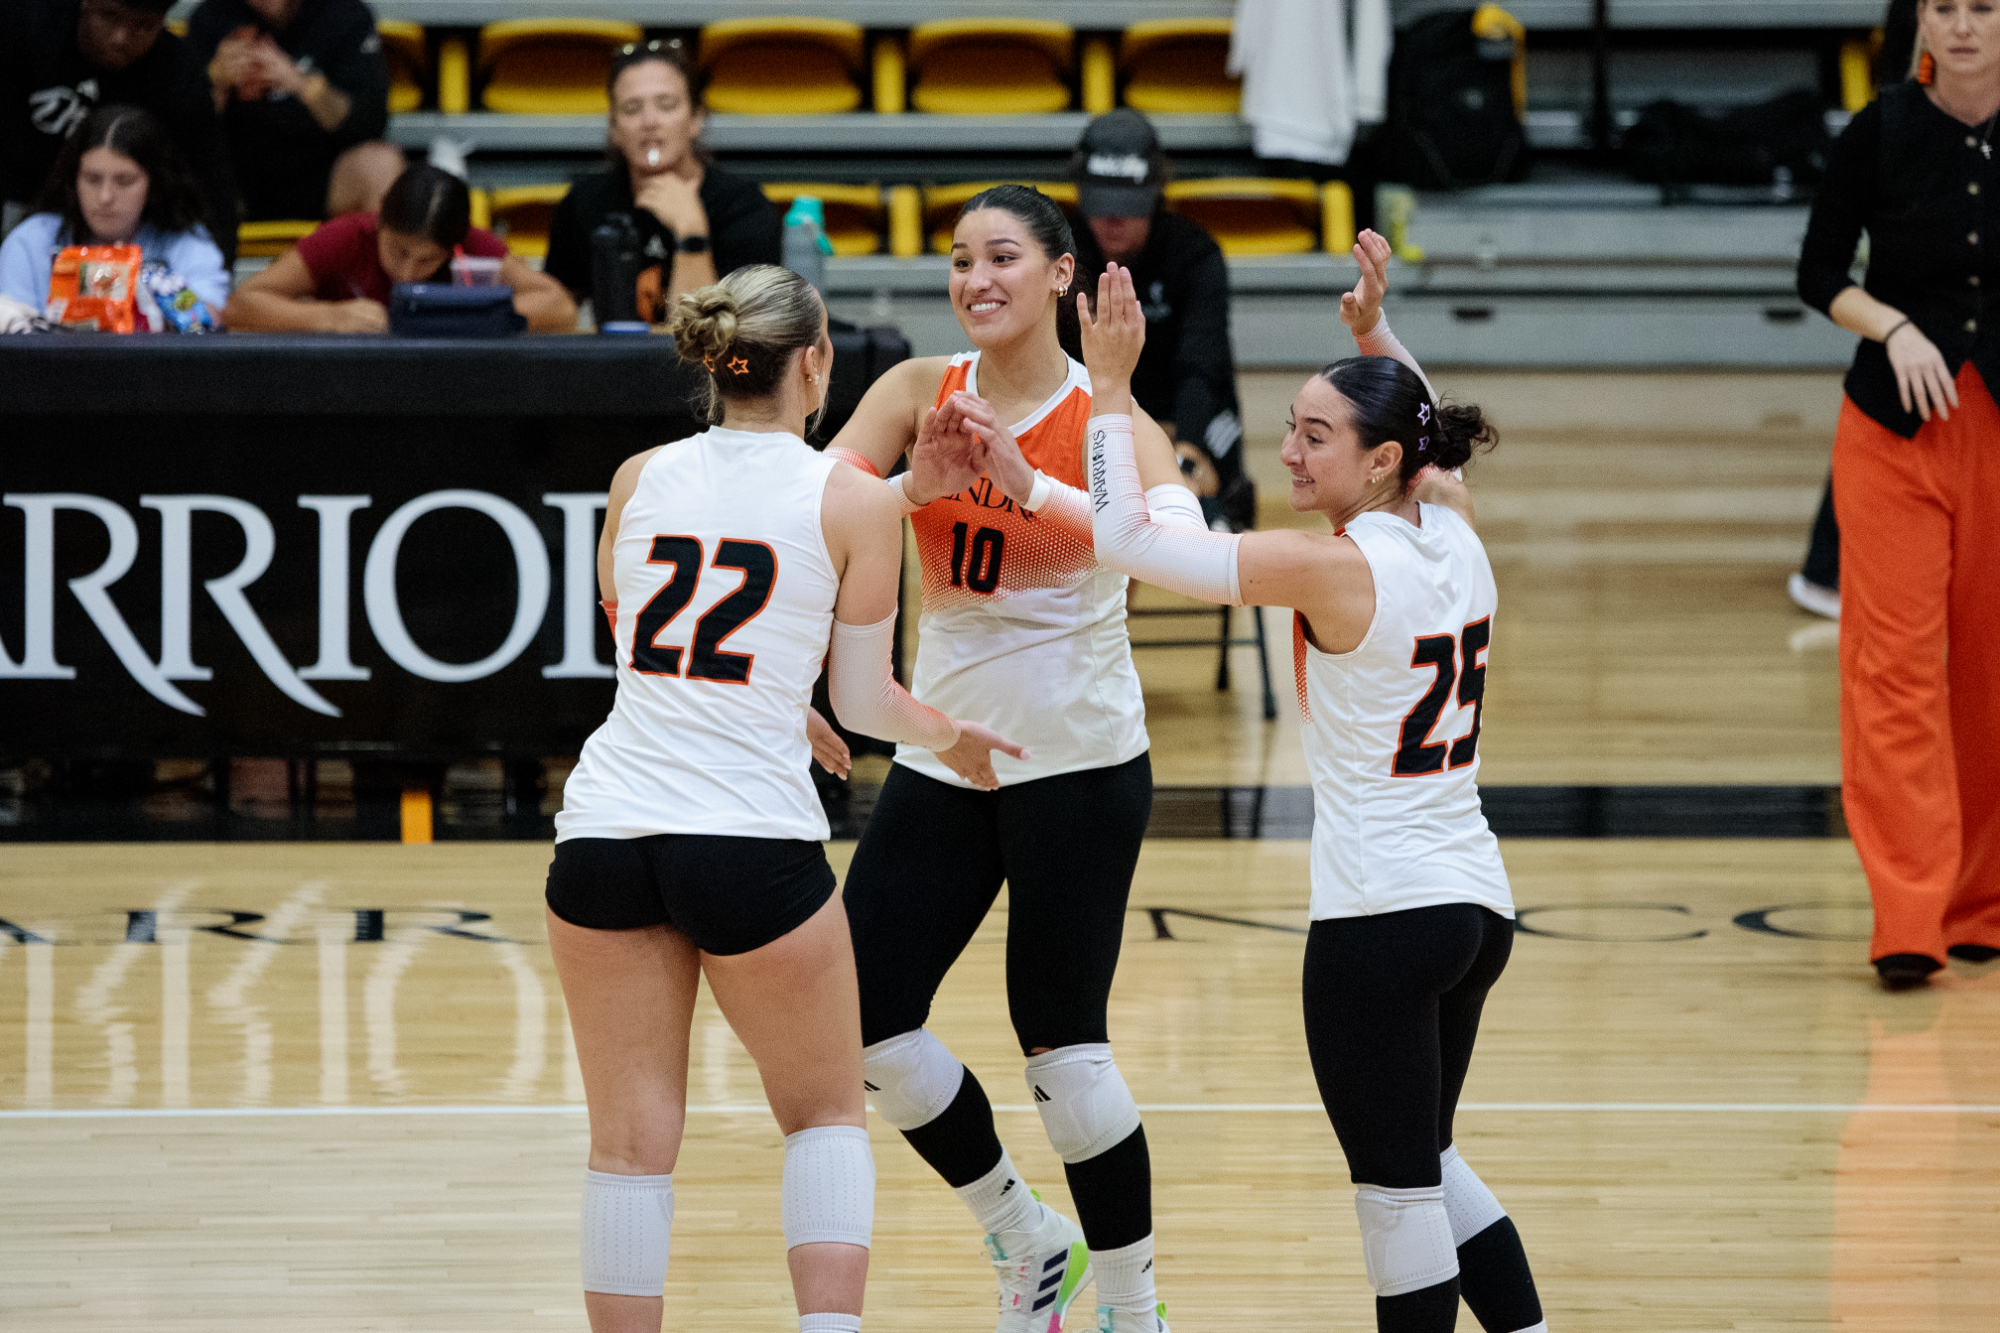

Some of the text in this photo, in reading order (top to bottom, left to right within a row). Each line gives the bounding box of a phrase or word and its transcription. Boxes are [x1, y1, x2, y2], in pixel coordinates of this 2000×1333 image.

[0, 488, 618, 718] RRIO
[628, 533, 779, 686] 22
[951, 521, 1005, 593] 10
[1390, 613, 1491, 778] 25
